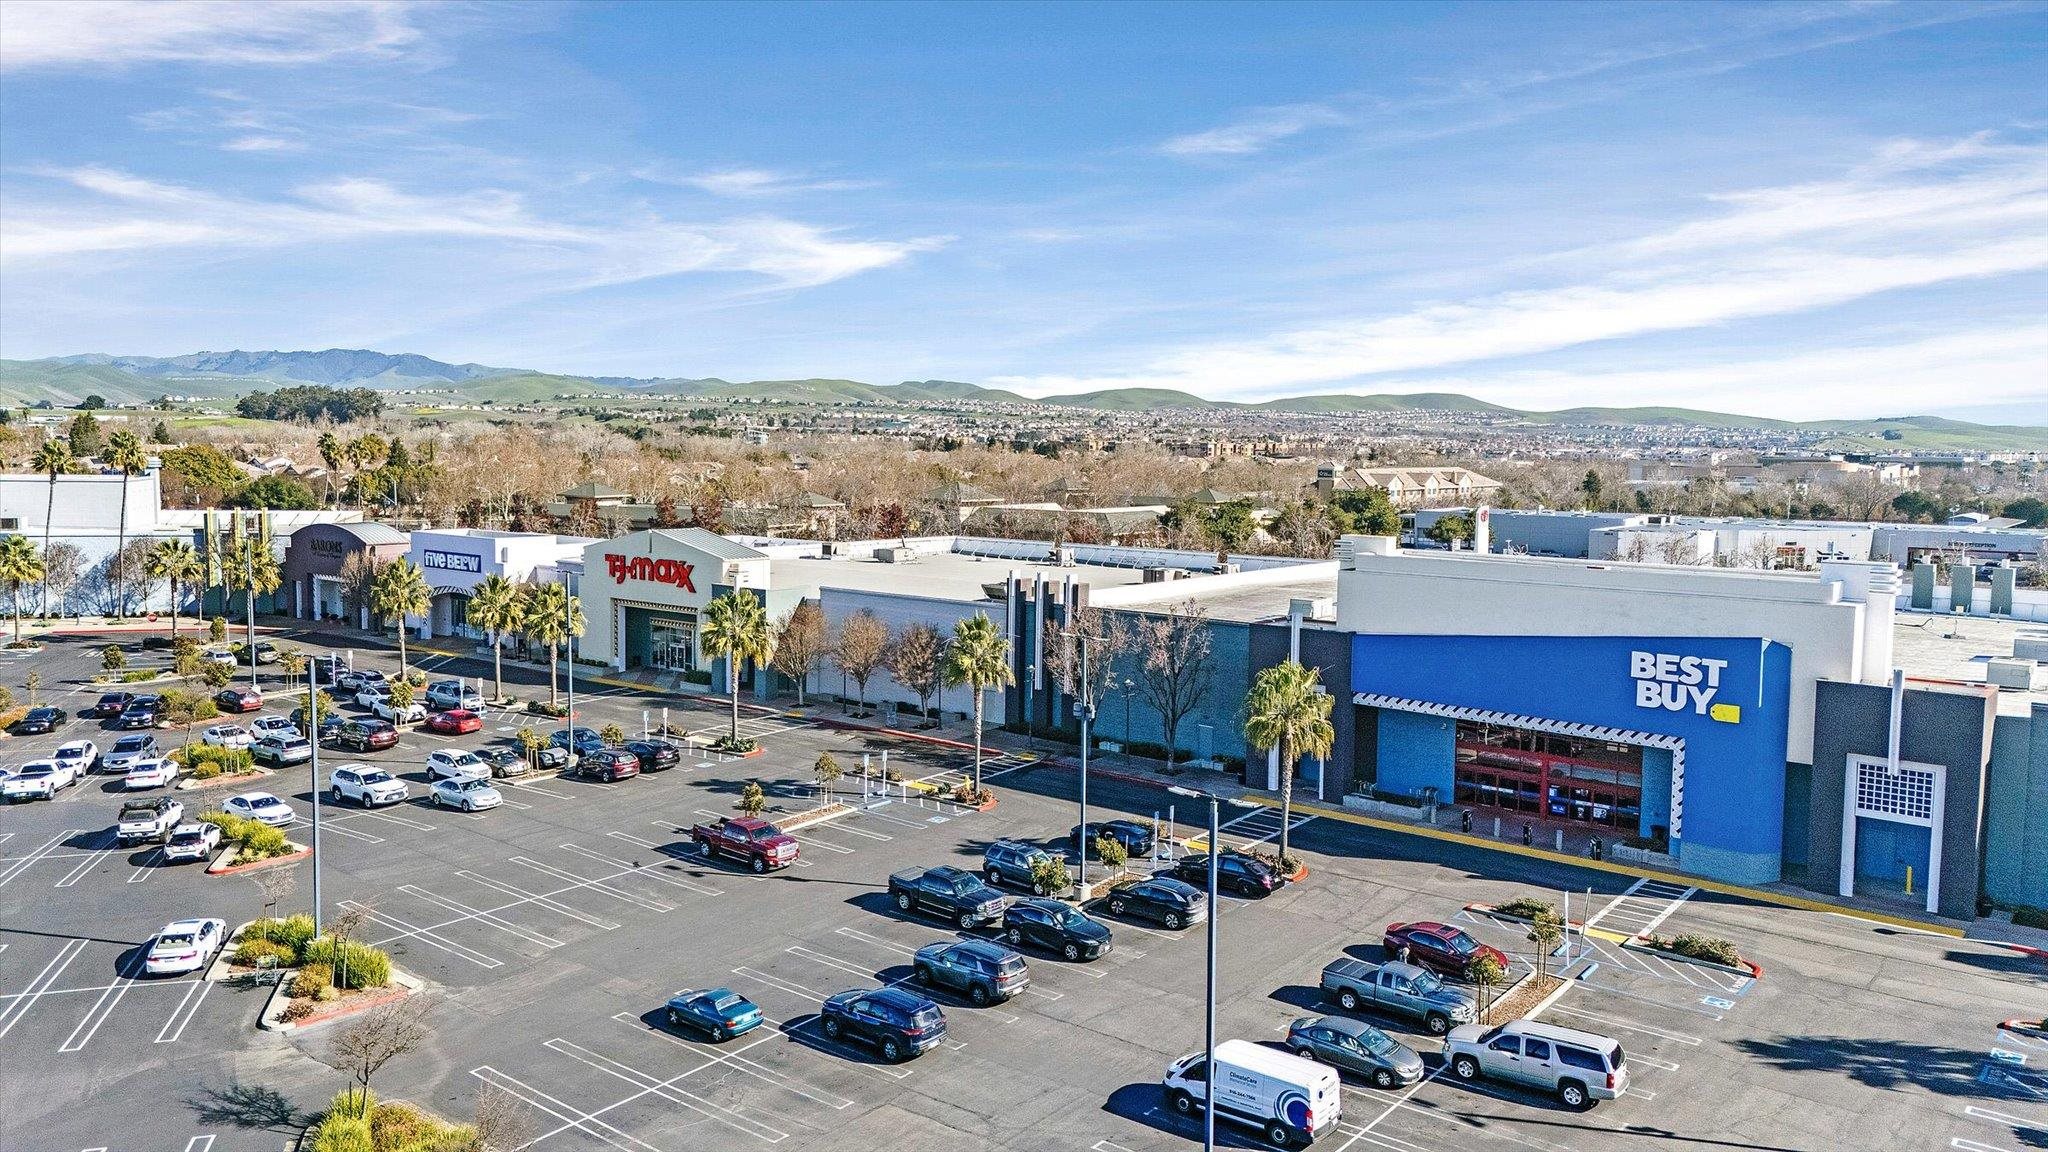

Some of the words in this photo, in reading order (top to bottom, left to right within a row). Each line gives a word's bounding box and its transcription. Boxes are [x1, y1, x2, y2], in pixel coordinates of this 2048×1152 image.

[425, 551, 446, 568] five
[447, 554, 479, 571] BELOW
[1631, 651, 1728, 687] BEST
[1636, 680, 1718, 715] BUY
